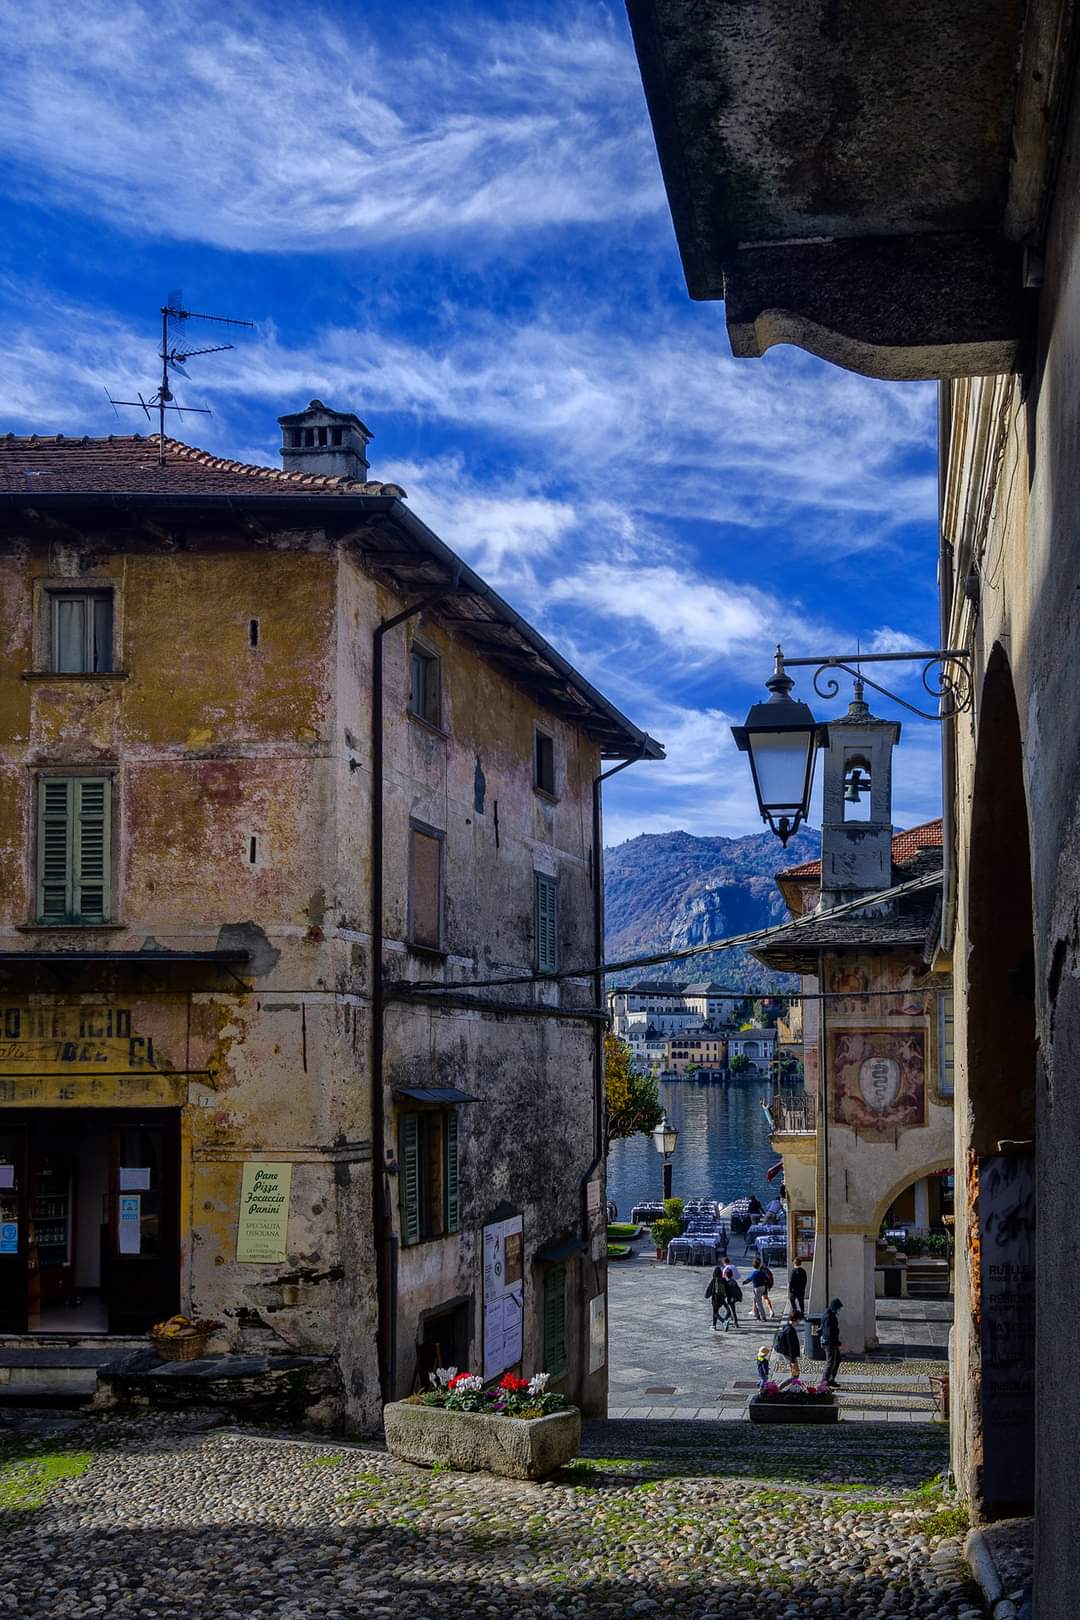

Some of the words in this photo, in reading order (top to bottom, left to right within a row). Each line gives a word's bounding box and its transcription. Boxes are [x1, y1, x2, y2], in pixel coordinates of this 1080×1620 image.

[255, 1170, 278, 1181] Pane
[253, 1181, 278, 1193] Pizza
[245, 1192, 285, 1203] Focaccia
[248, 1203, 280, 1215] Panini
